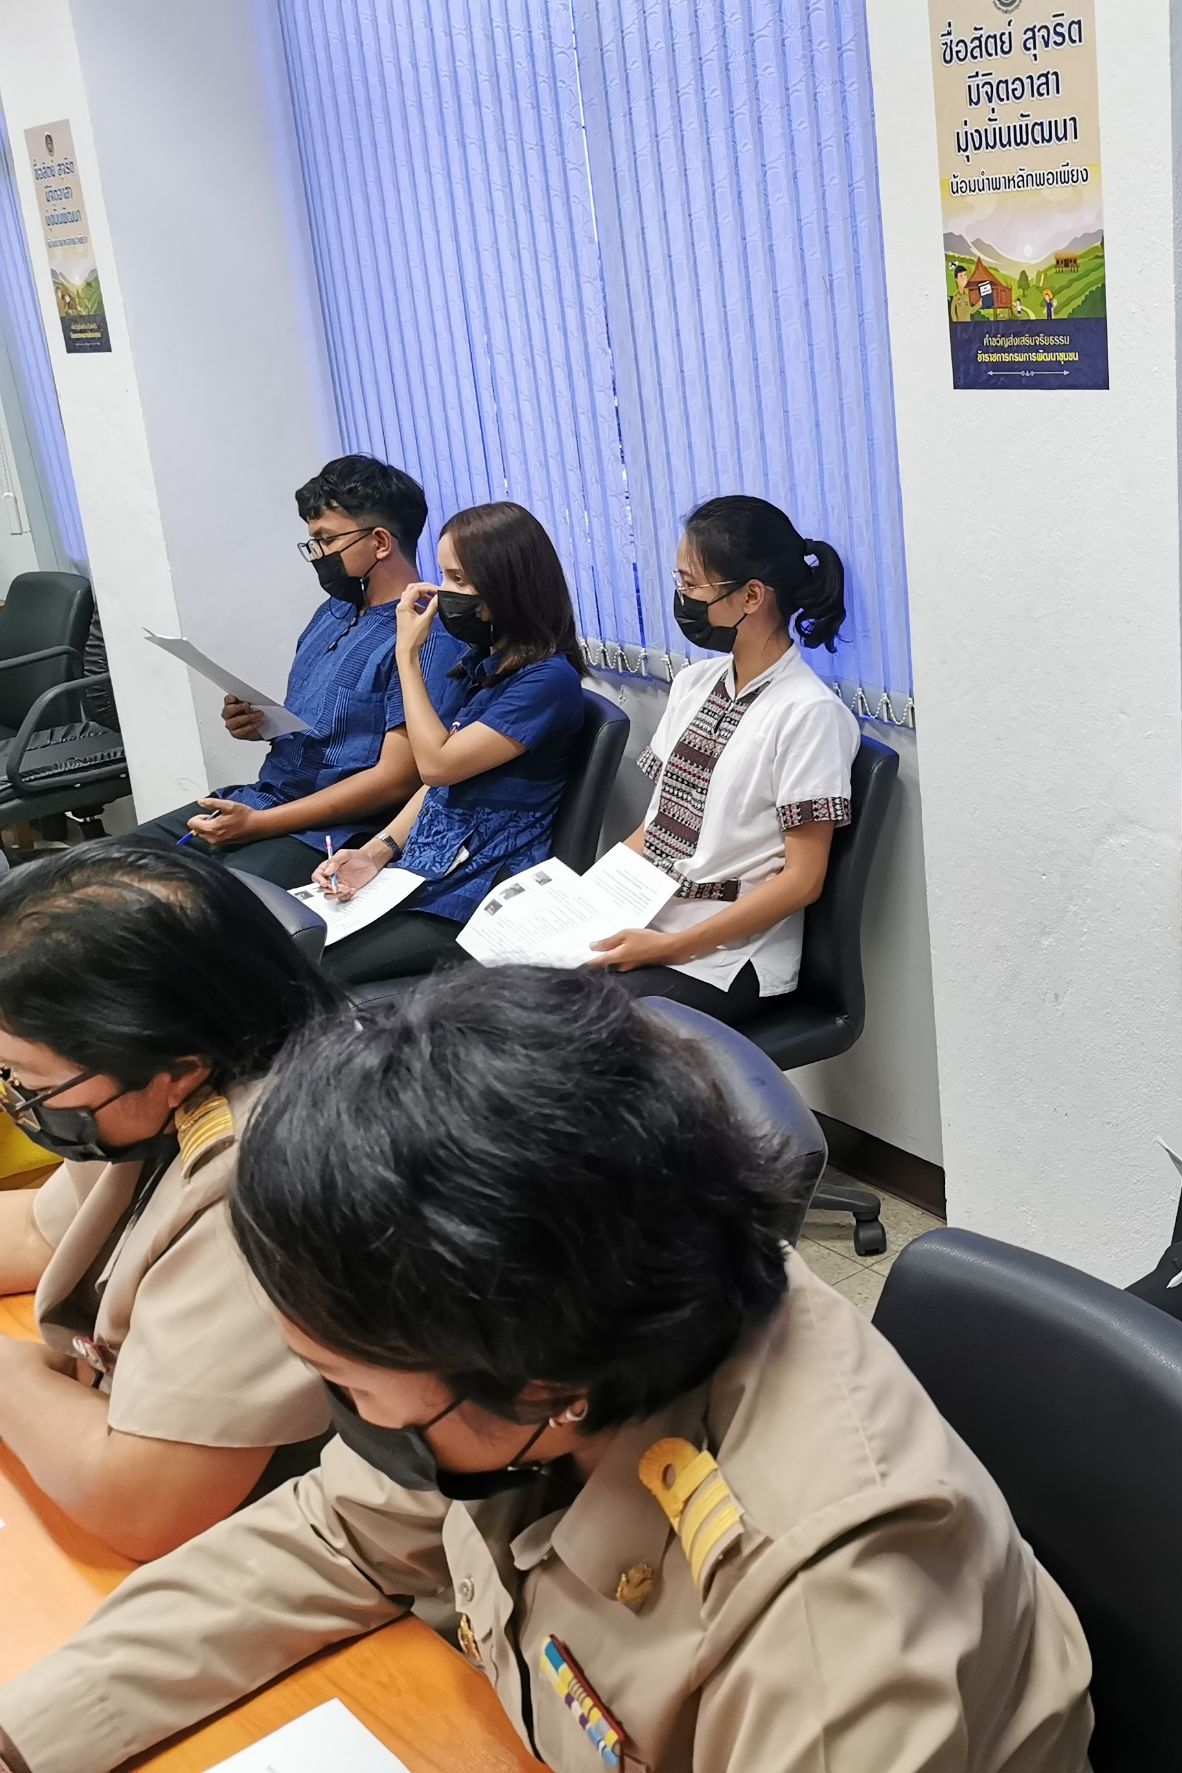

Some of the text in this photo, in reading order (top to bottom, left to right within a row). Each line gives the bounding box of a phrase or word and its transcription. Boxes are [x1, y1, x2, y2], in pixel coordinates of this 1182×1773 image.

[941, 12, 1083, 65] ซื่อสัตย์ สุจริต
[967, 70, 1060, 107] มีจิตอาสา
[956, 107, 1078, 162] มุ่งมั่นพัฒนา
[950, 162, 1089, 195] น้อมนำพาหลักพอเพียง
